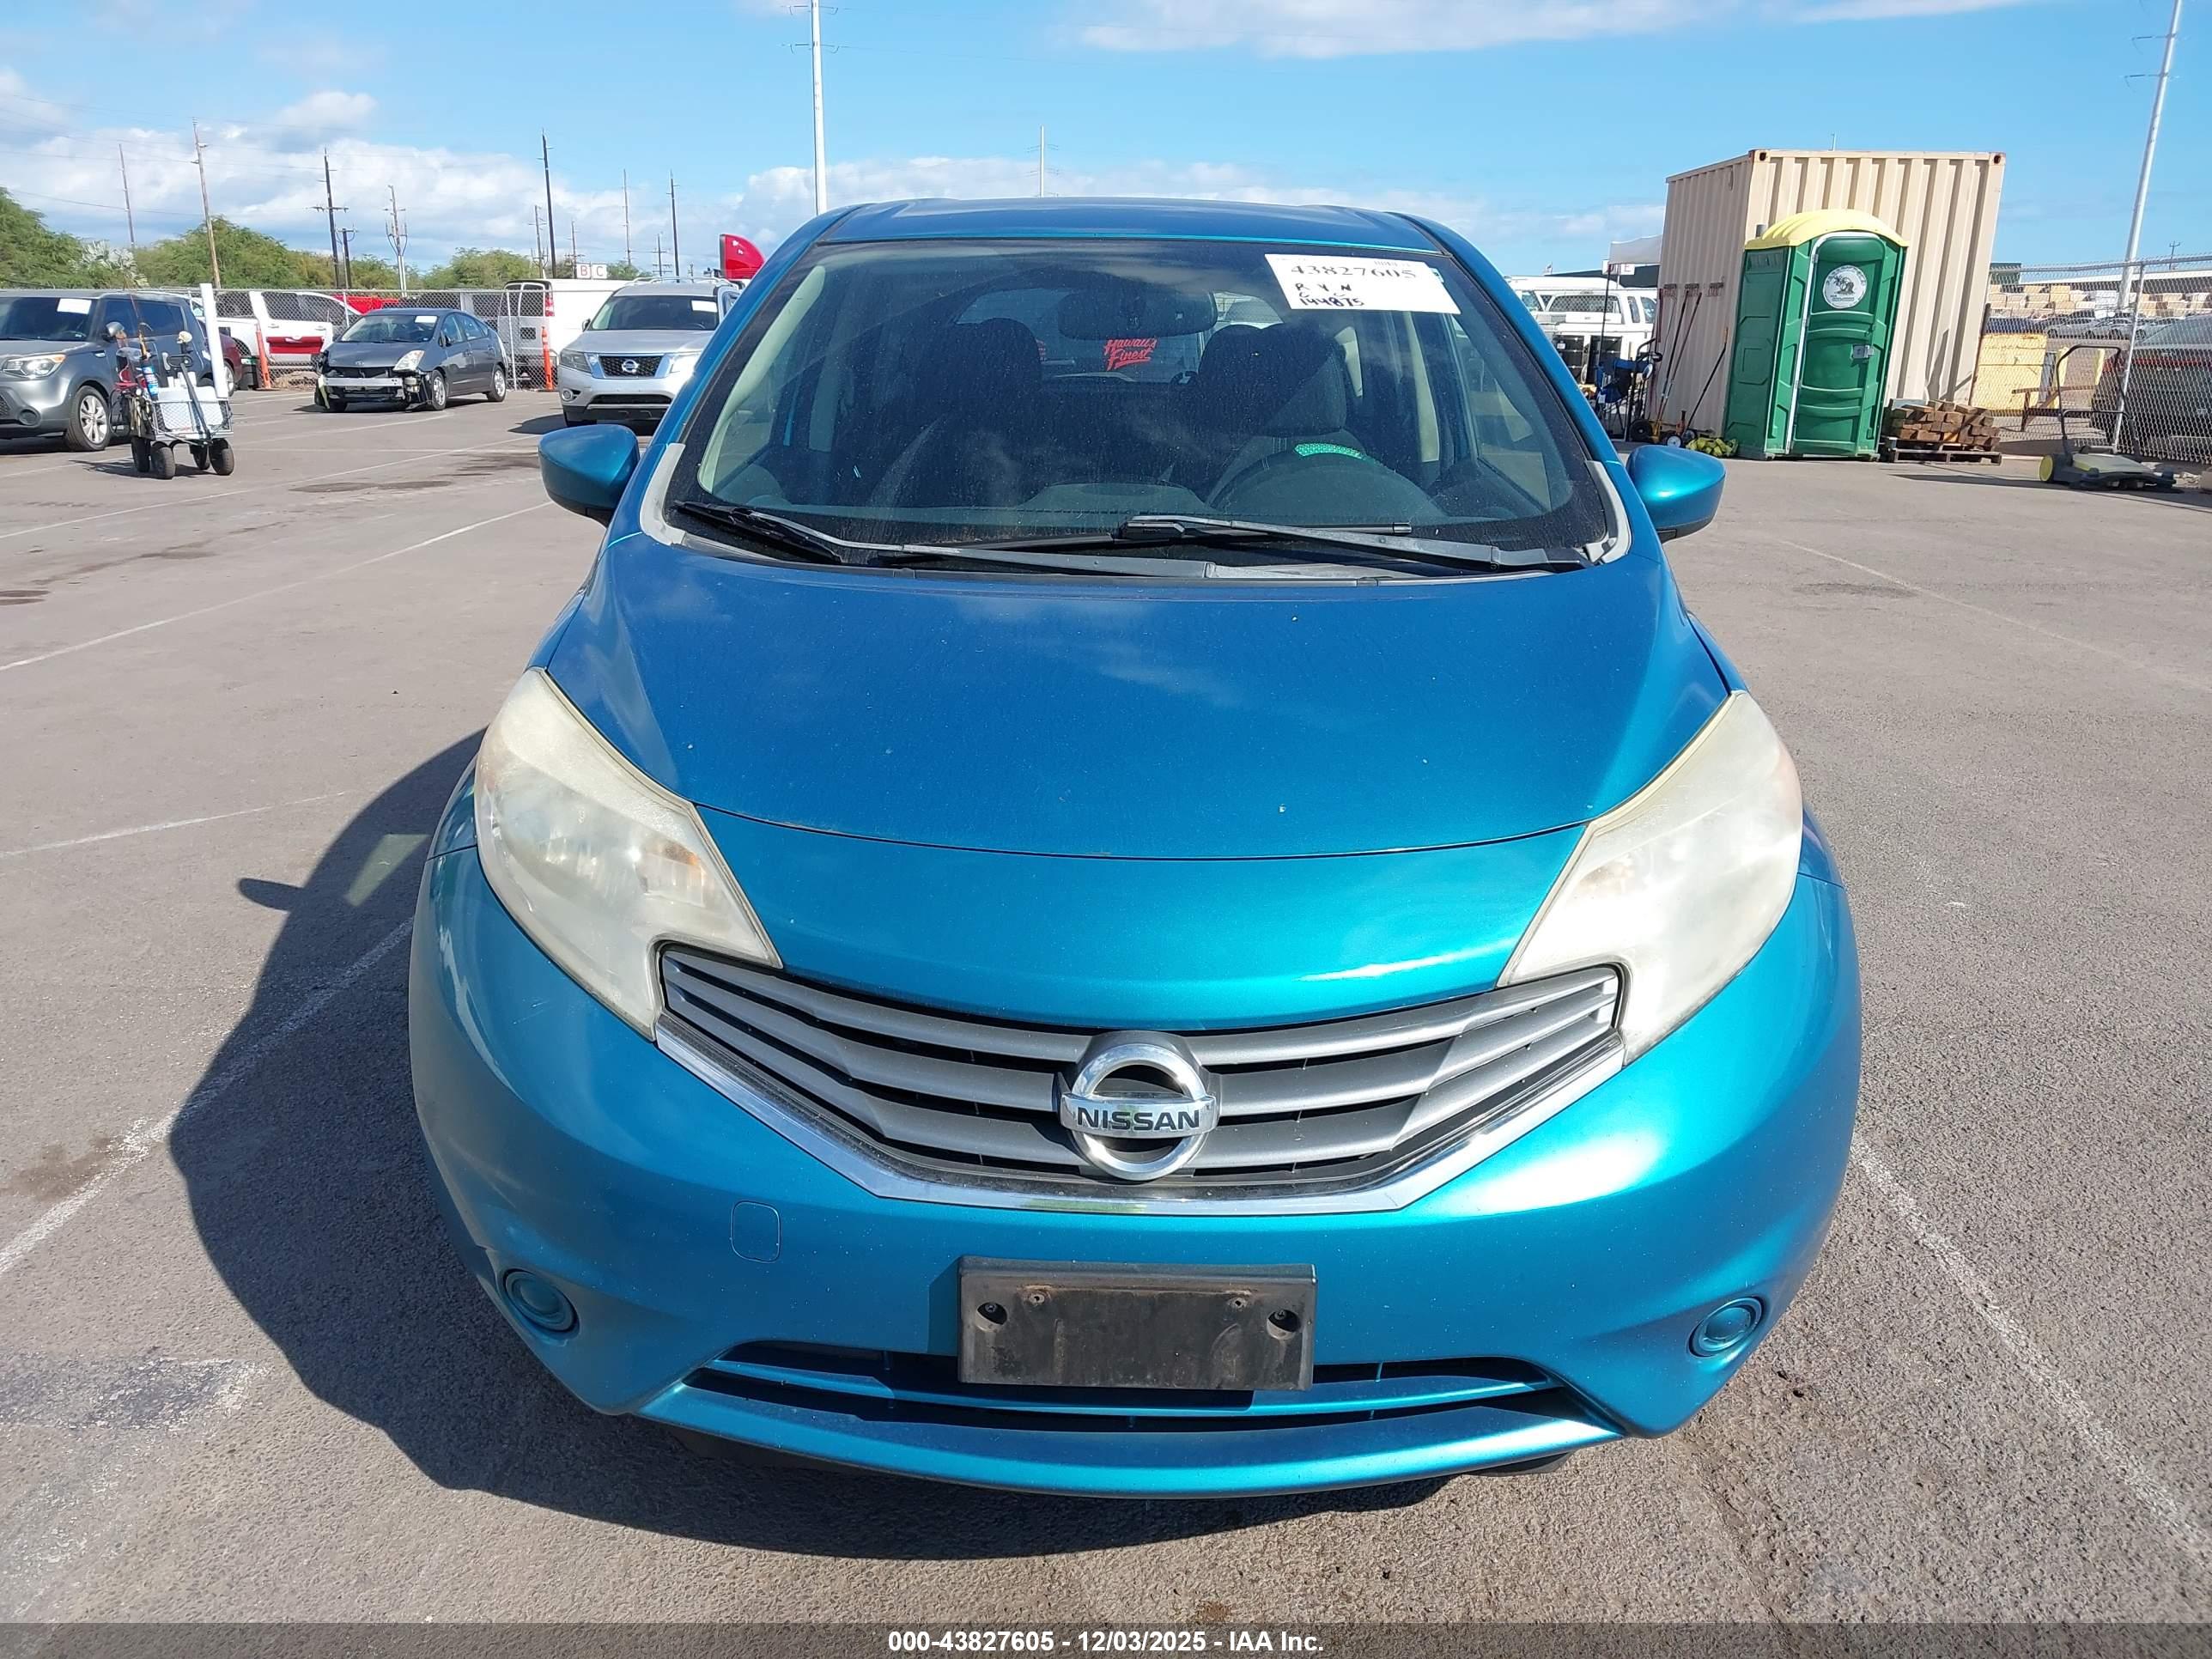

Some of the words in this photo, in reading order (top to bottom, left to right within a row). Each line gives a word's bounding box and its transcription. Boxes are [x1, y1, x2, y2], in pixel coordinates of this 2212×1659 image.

[580, 265, 588, 276] B
[597, 265, 604, 276] C
[1107, 347, 1153, 371] Finest
[1077, 1106, 1200, 1132] NISSAN
